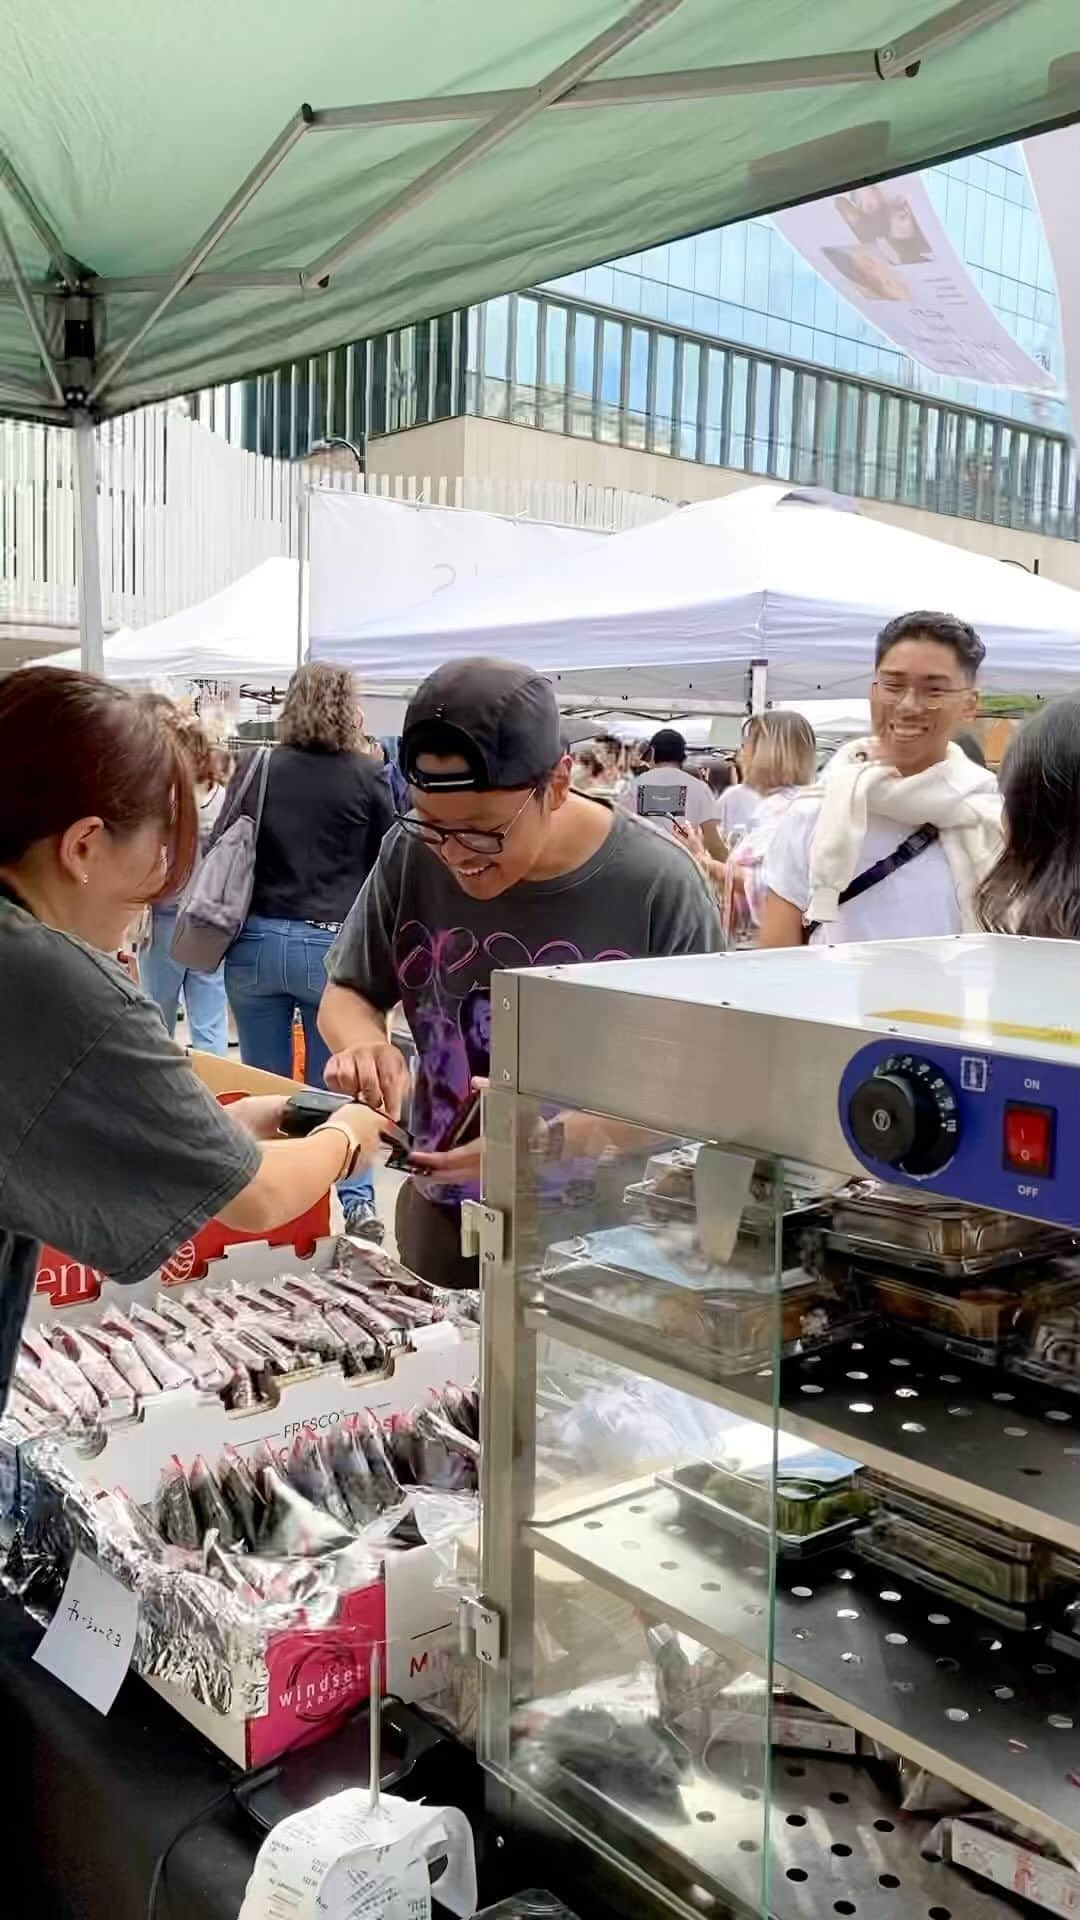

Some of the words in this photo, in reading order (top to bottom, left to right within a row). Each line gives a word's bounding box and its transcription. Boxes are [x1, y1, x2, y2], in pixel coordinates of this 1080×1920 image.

[1023, 1078, 1041, 1090] ON
[1017, 1184, 1039, 1200] OFF
[284, 1411, 340, 1439] FRESCO
[279, 1664, 365, 1708] windset
